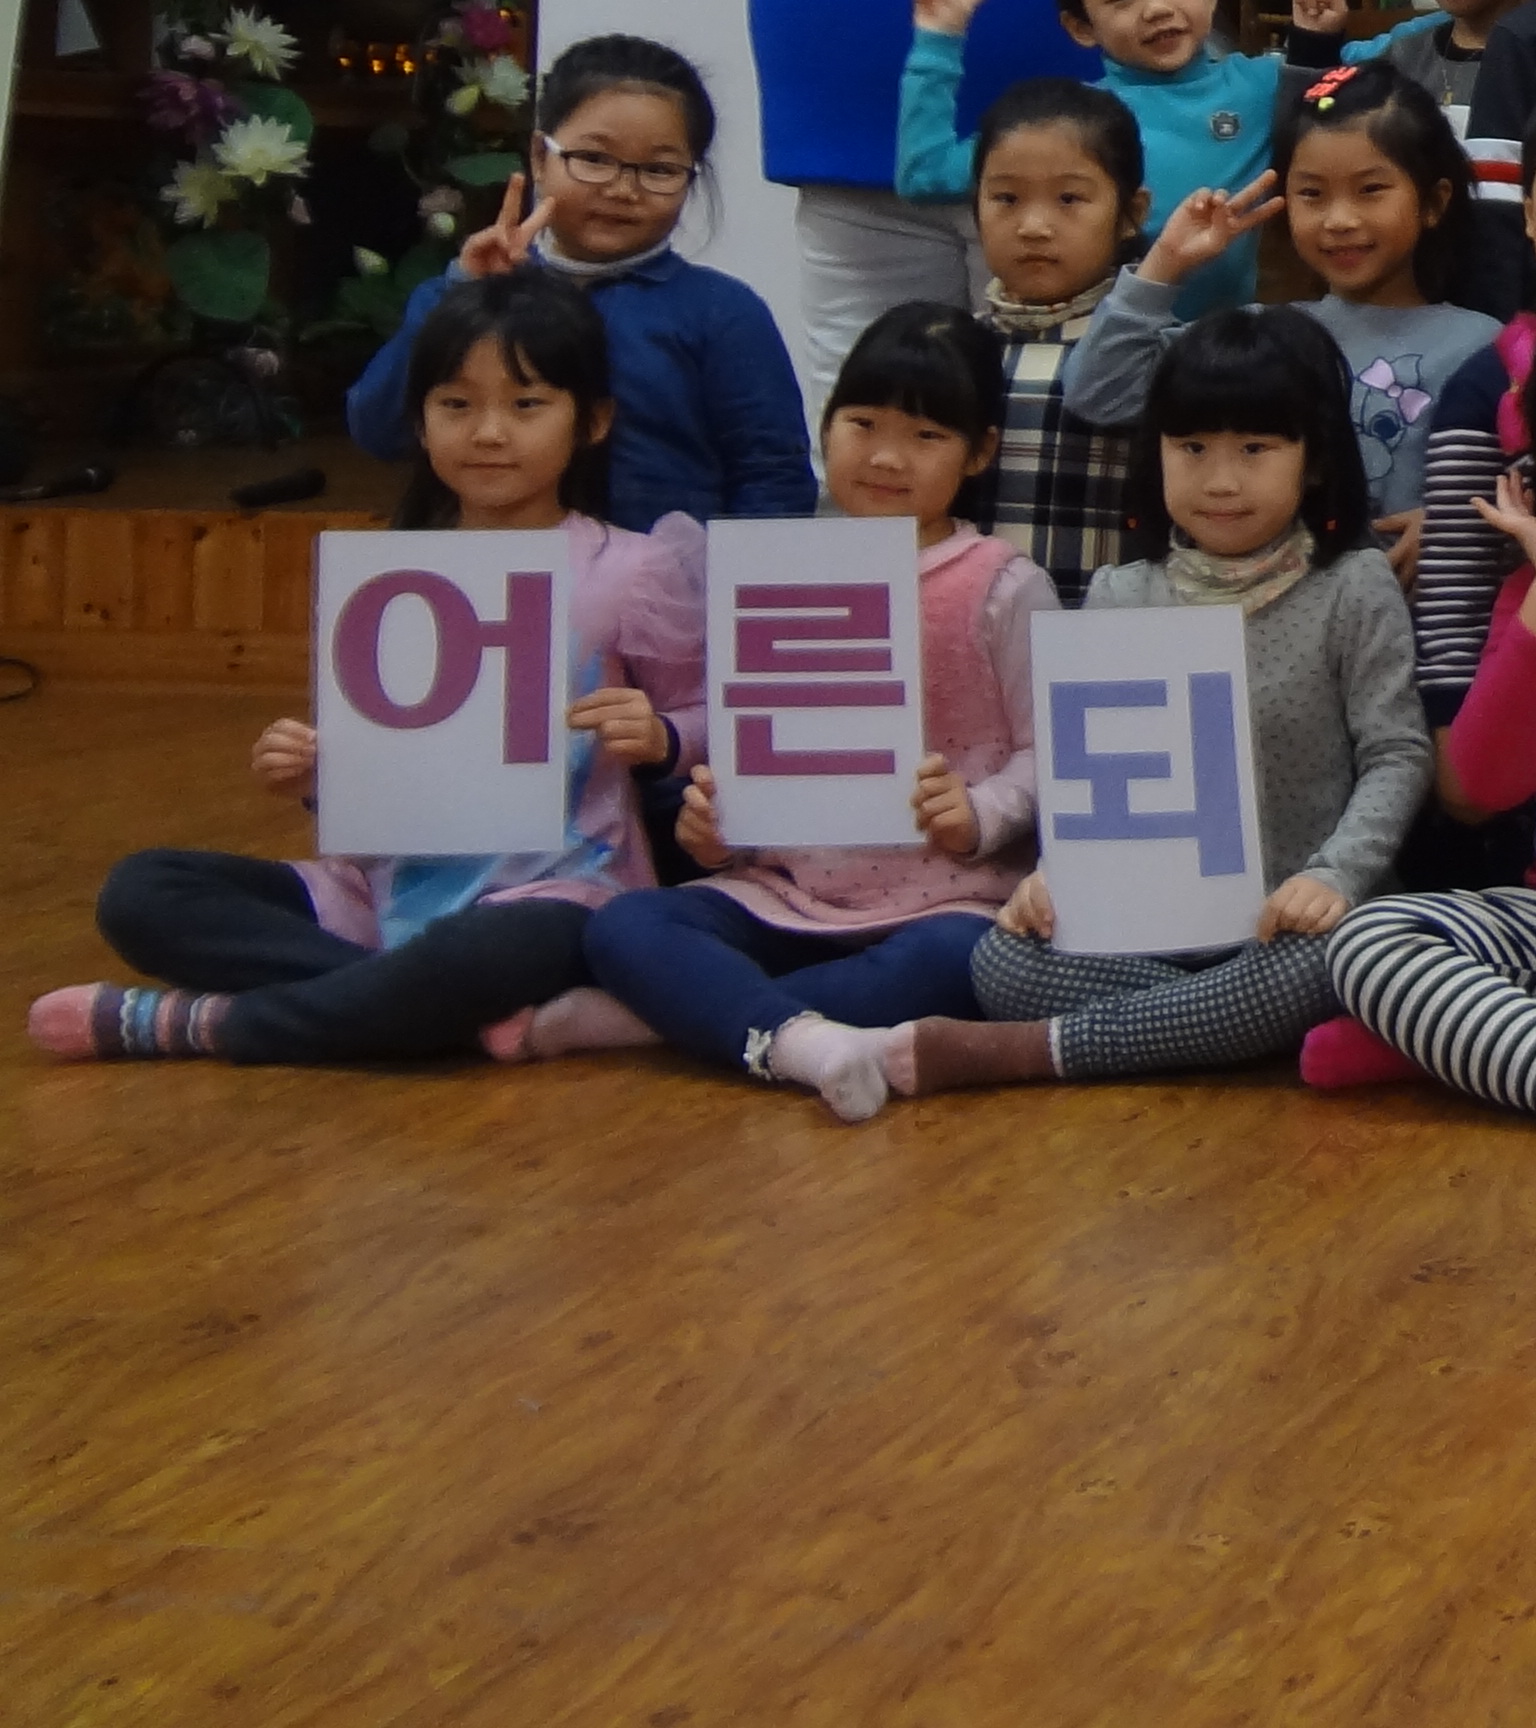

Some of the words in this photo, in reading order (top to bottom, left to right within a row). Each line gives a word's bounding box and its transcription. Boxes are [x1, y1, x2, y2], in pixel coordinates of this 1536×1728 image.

[333, 569, 553, 764] 어
[723, 583, 905, 776] 른
[1048, 672, 1246, 877] 되
